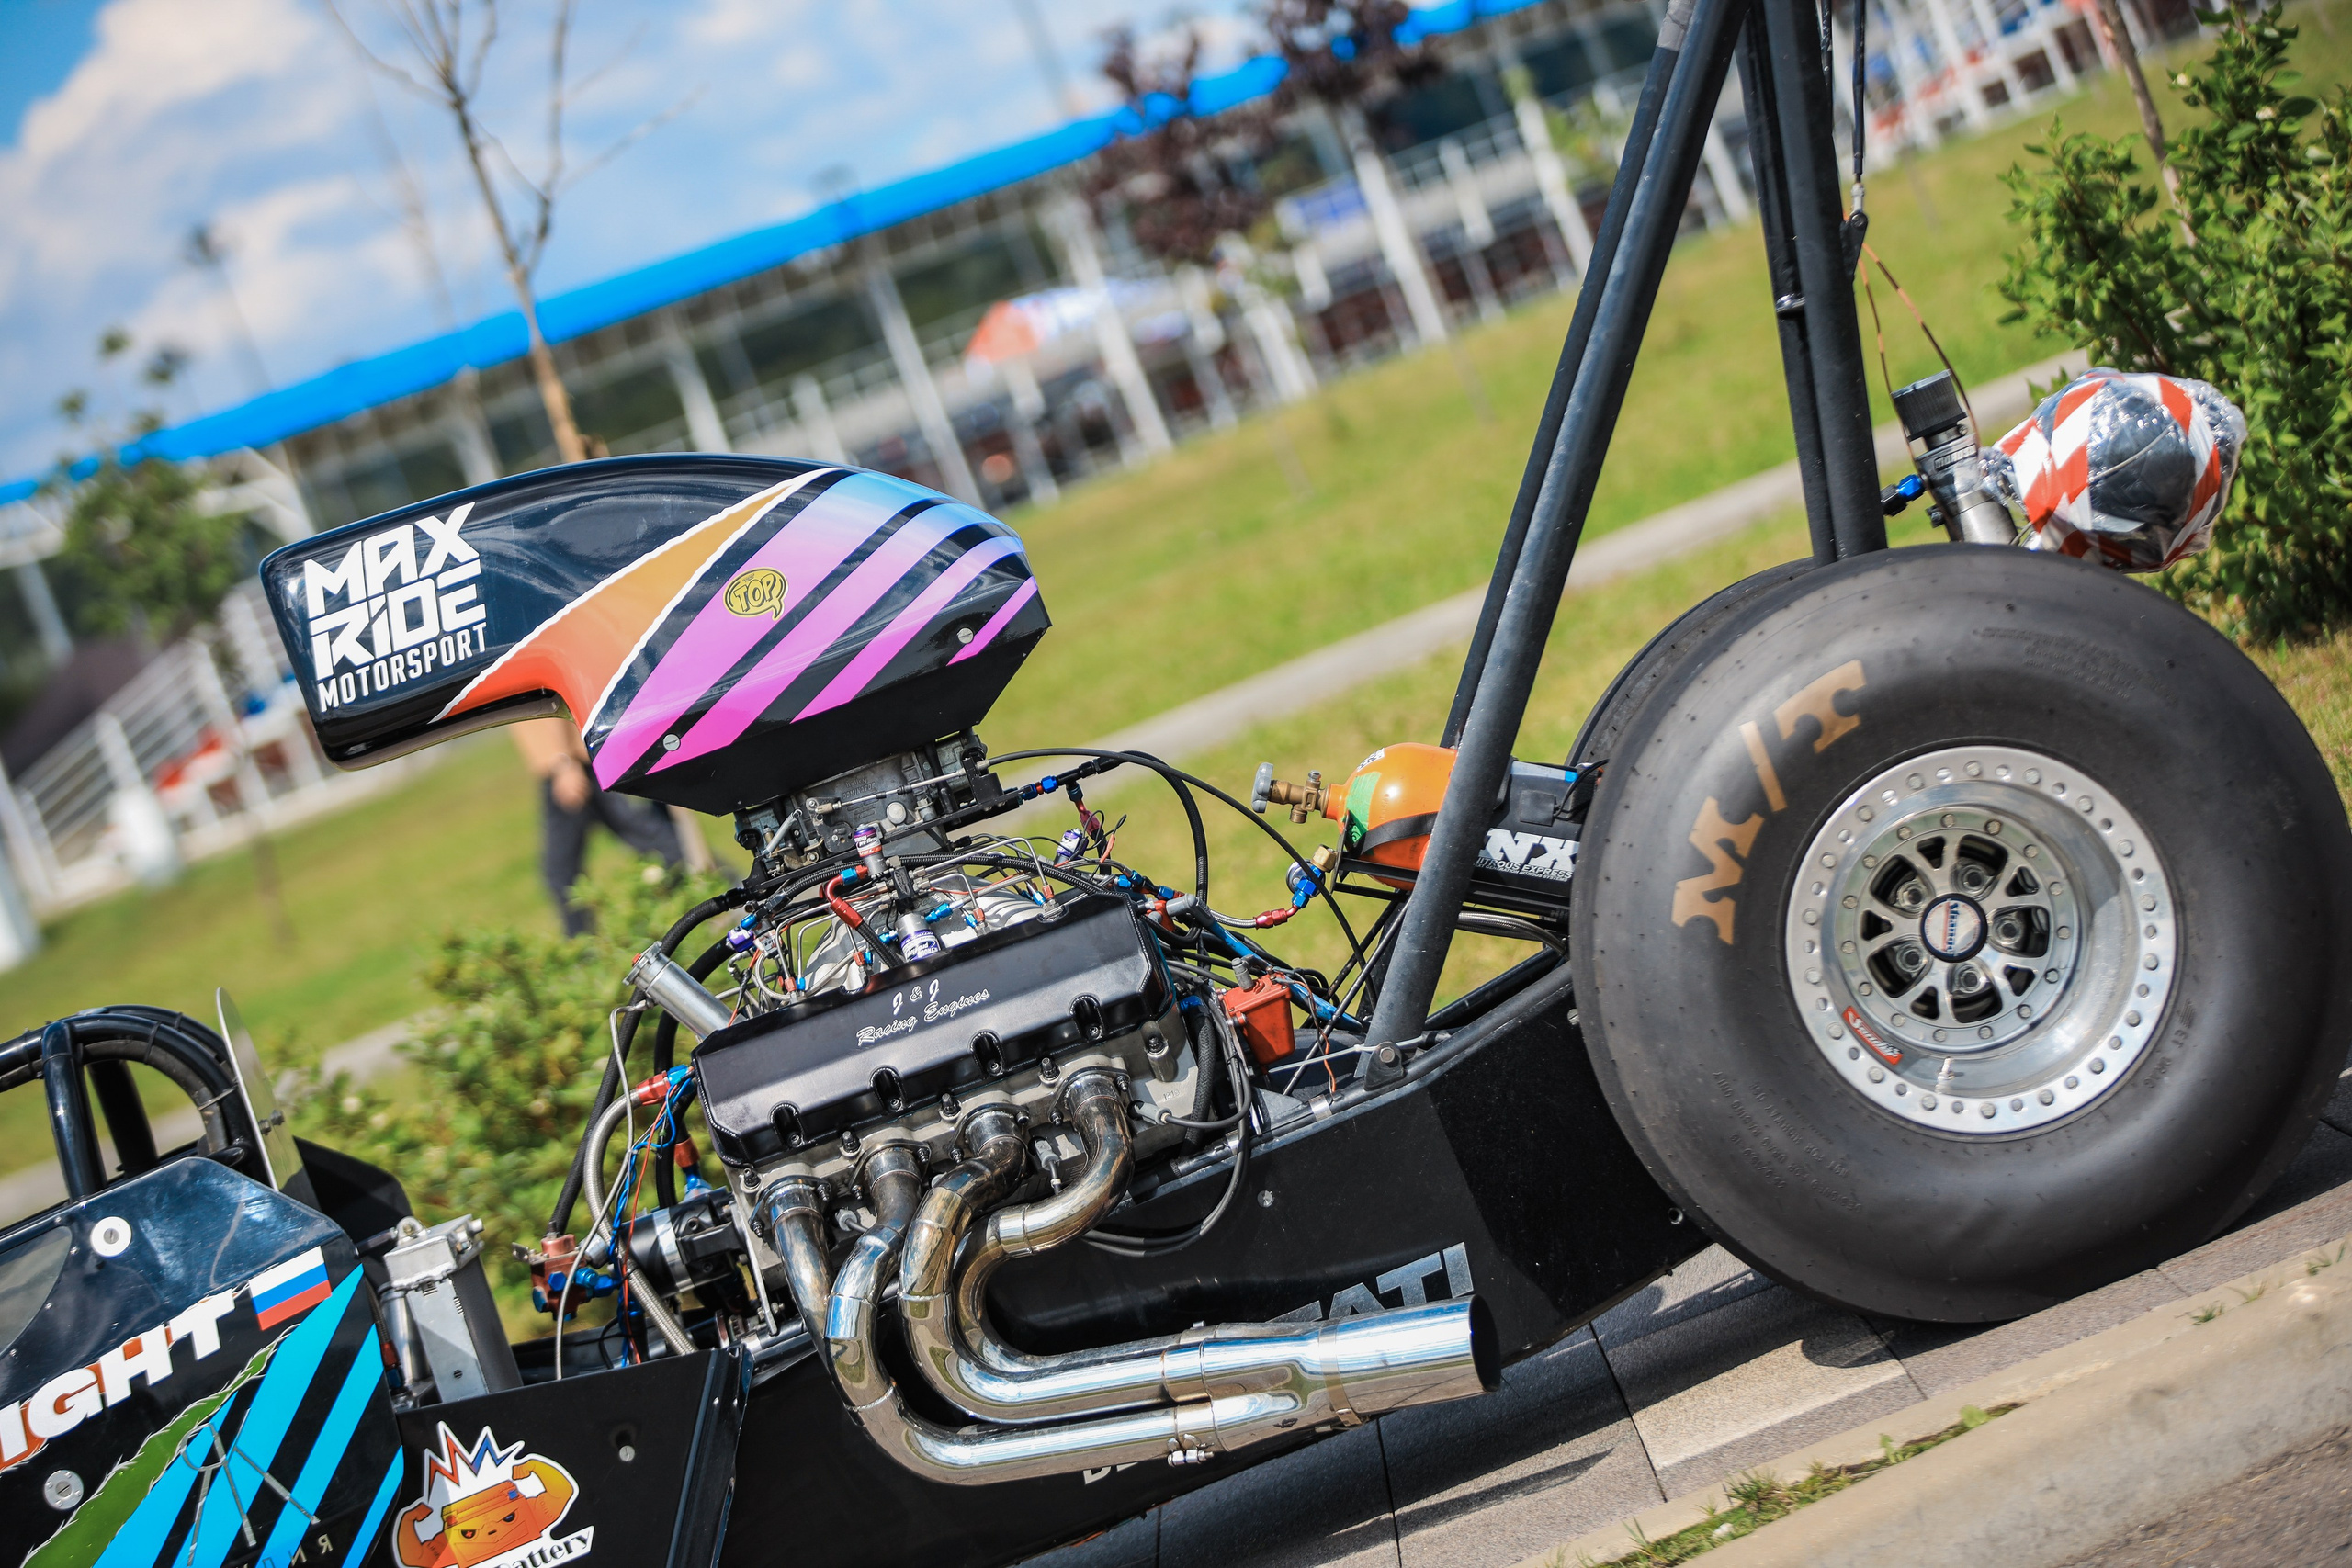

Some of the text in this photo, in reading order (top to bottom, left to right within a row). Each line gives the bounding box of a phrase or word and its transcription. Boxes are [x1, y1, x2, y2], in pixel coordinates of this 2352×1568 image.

[304, 502, 481, 620] MAX
[733, 573, 776, 613] TOP
[310, 559, 487, 680] RIDE
[318, 622, 487, 713] MOTORSPORT
[1477, 828, 1580, 873] NX
[1521, 863, 1574, 879] EXPRESS
[855, 988, 990, 1047] Racing Engines
[892, 978, 941, 1015] J & J
[494, 1530, 591, 1568] attery
